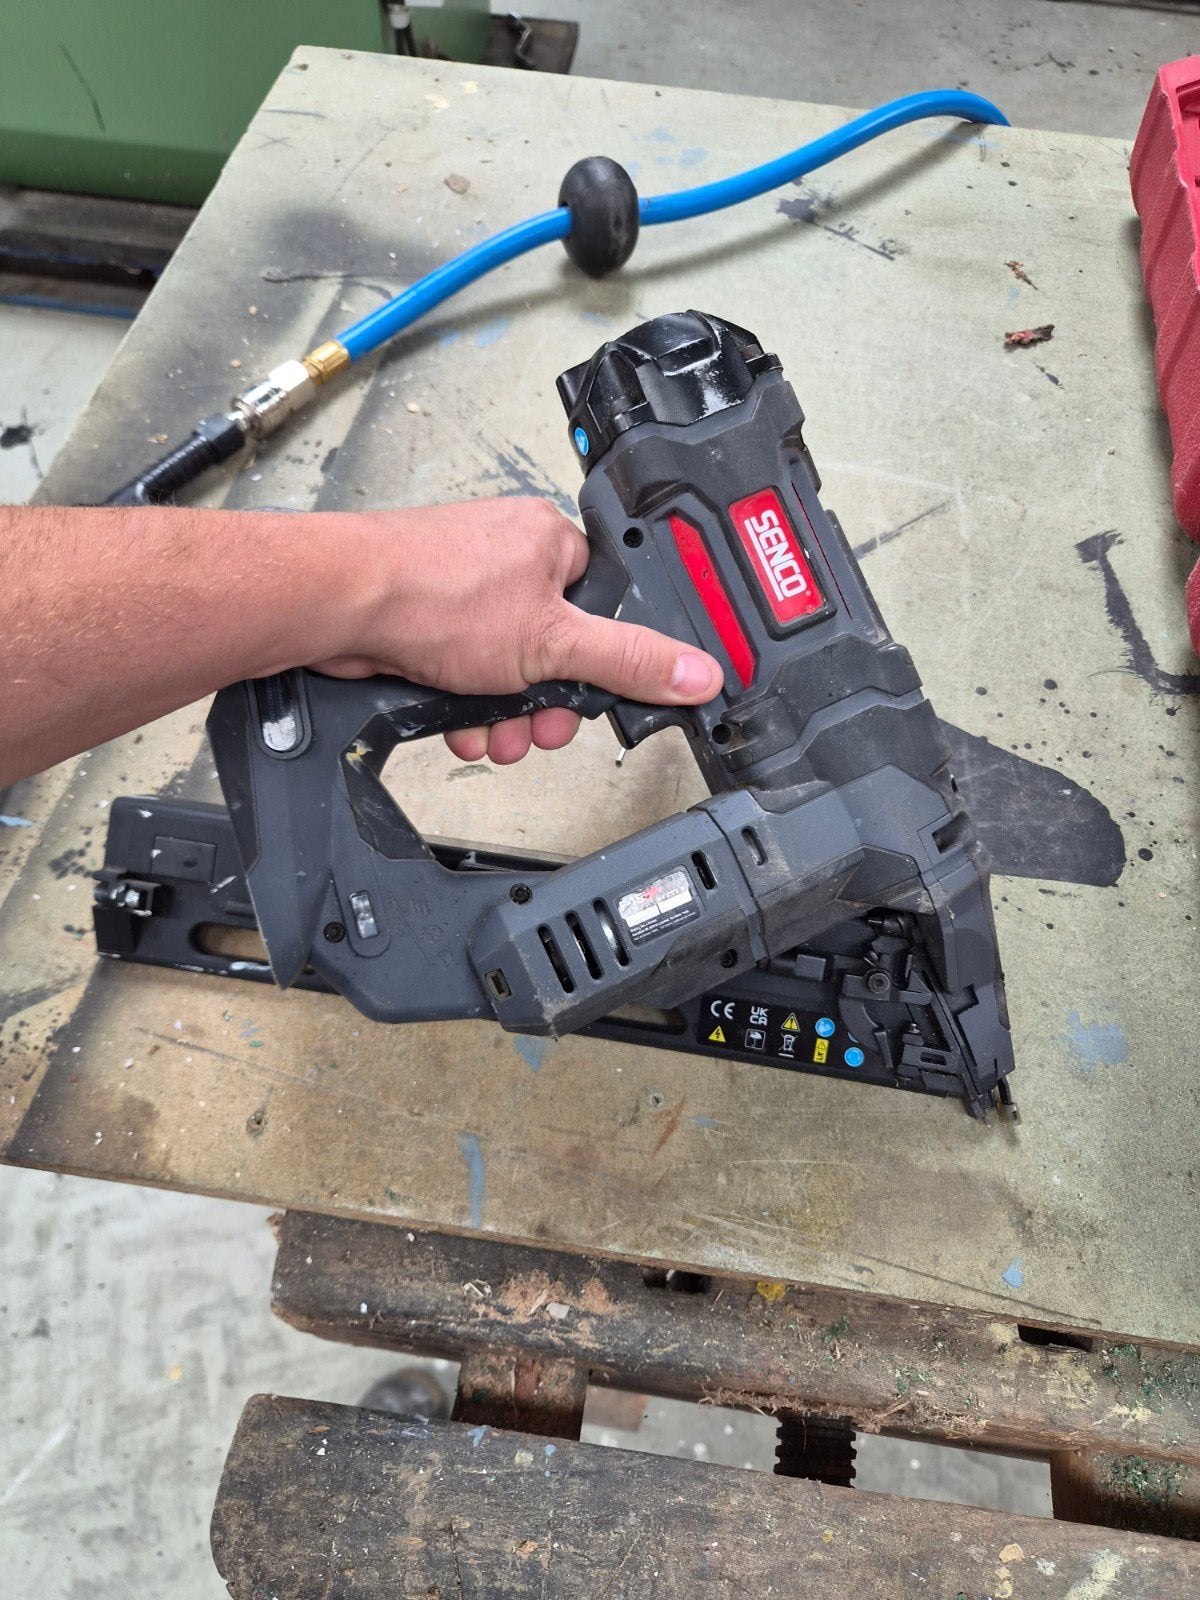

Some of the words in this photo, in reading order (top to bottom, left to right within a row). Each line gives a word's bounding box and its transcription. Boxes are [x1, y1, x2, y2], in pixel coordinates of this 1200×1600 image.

[750, 509, 808, 598] SENCO
[710, 1000, 736, 1020] CE
[750, 1006, 769, 1017] UK
[749, 1014, 768, 1026] CA
